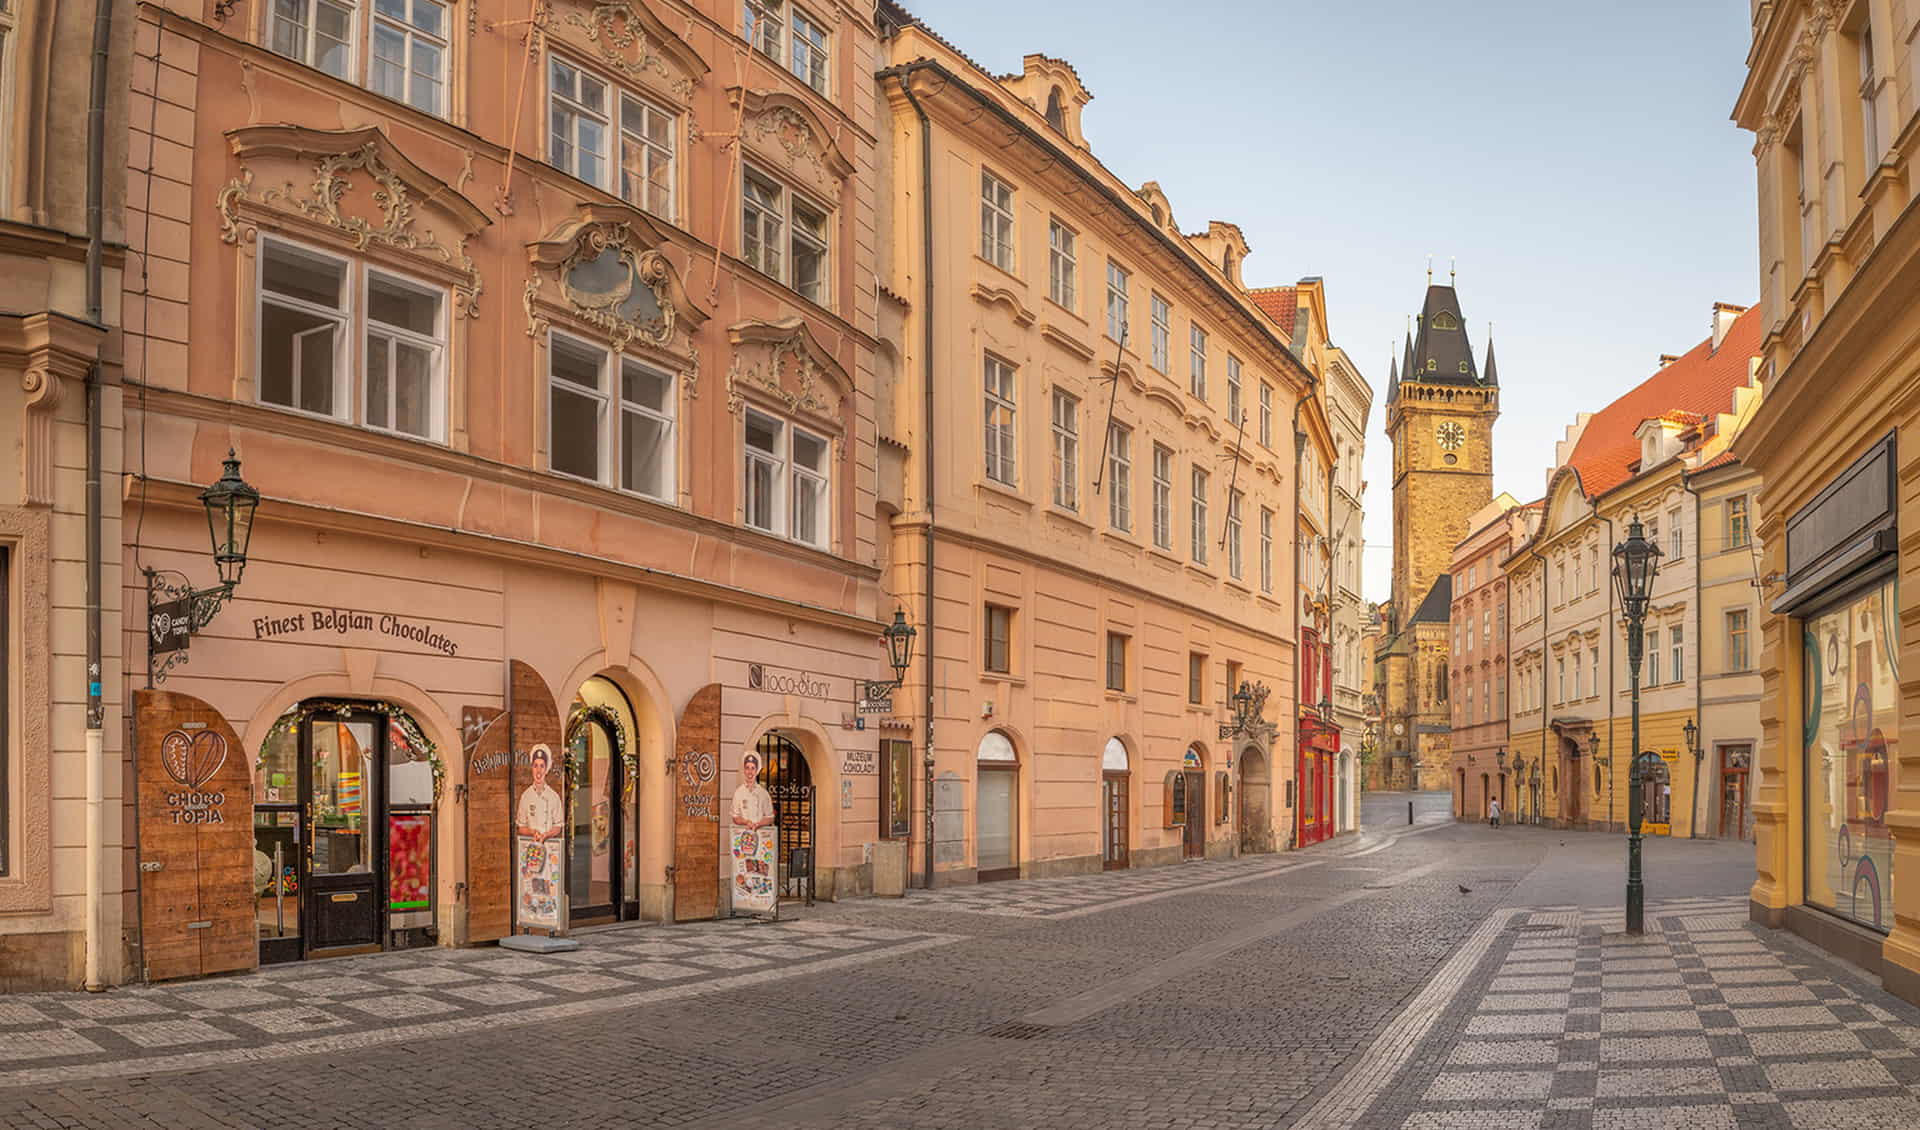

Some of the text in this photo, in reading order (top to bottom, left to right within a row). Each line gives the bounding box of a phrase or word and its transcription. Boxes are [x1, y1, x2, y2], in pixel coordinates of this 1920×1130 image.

[253, 608, 458, 656] Finest Belgian Chocolates
[847, 752, 872, 761] MUZEUM
[168, 791, 225, 806] CHOCO
[683, 794, 713, 805] CANDY
[169, 809, 225, 825] TOPIA
